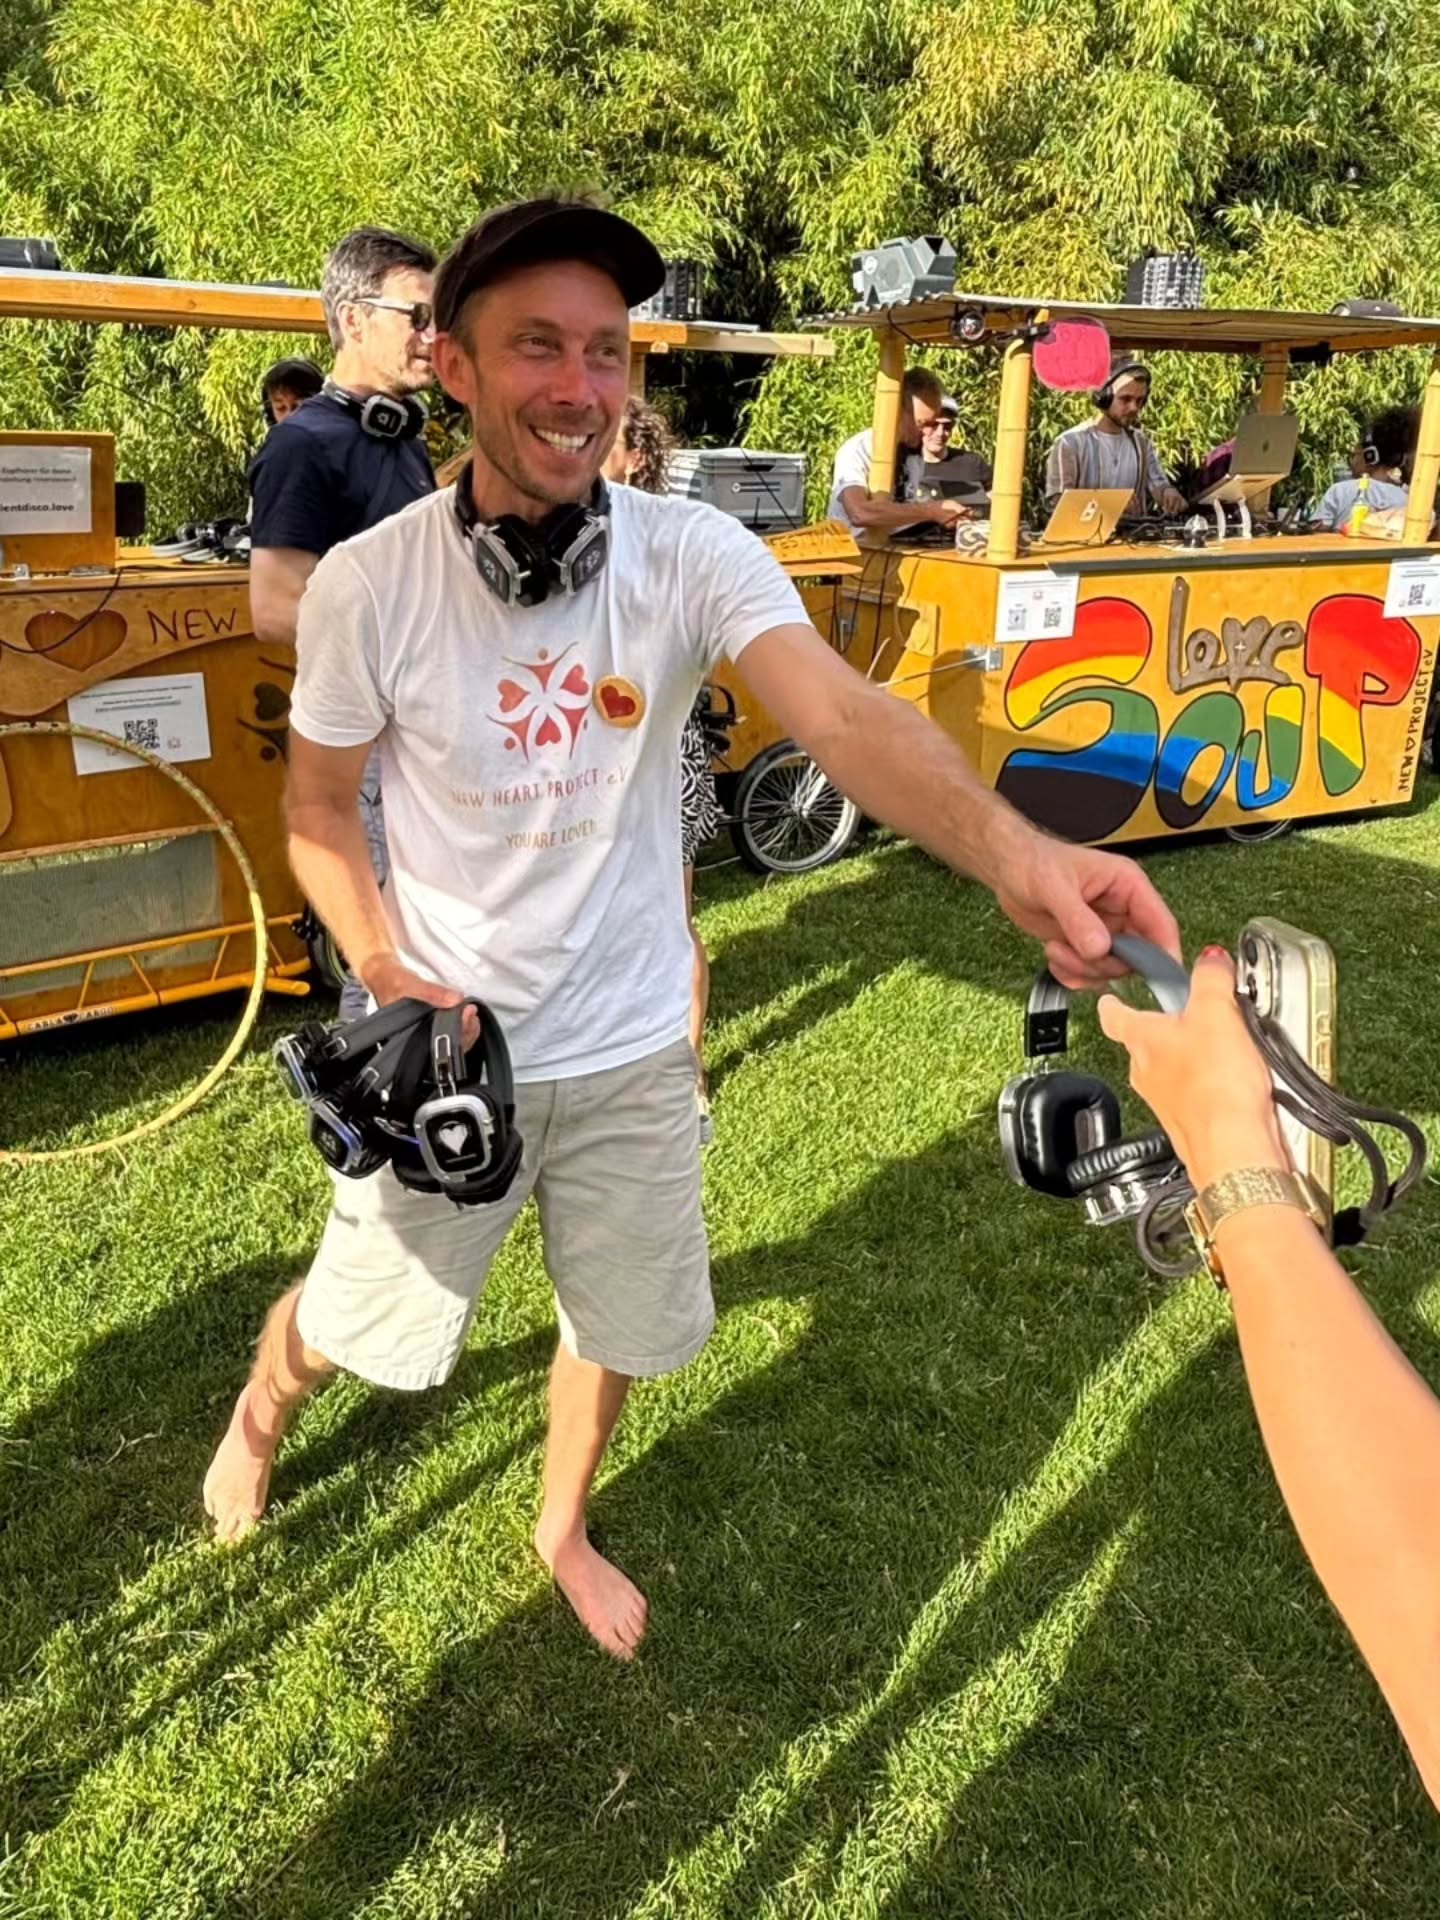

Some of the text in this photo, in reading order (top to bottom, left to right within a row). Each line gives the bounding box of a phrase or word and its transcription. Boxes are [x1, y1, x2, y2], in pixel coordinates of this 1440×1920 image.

[147, 607, 237, 645] NEW
[1398, 755, 1414, 792] NEW
[1408, 669, 1429, 735] PROJECT
[492, 783, 541, 807] HEART
[547, 768, 600, 799] PROJECT
[505, 832, 531, 850] YOU
[533, 831, 557, 849] ARE
